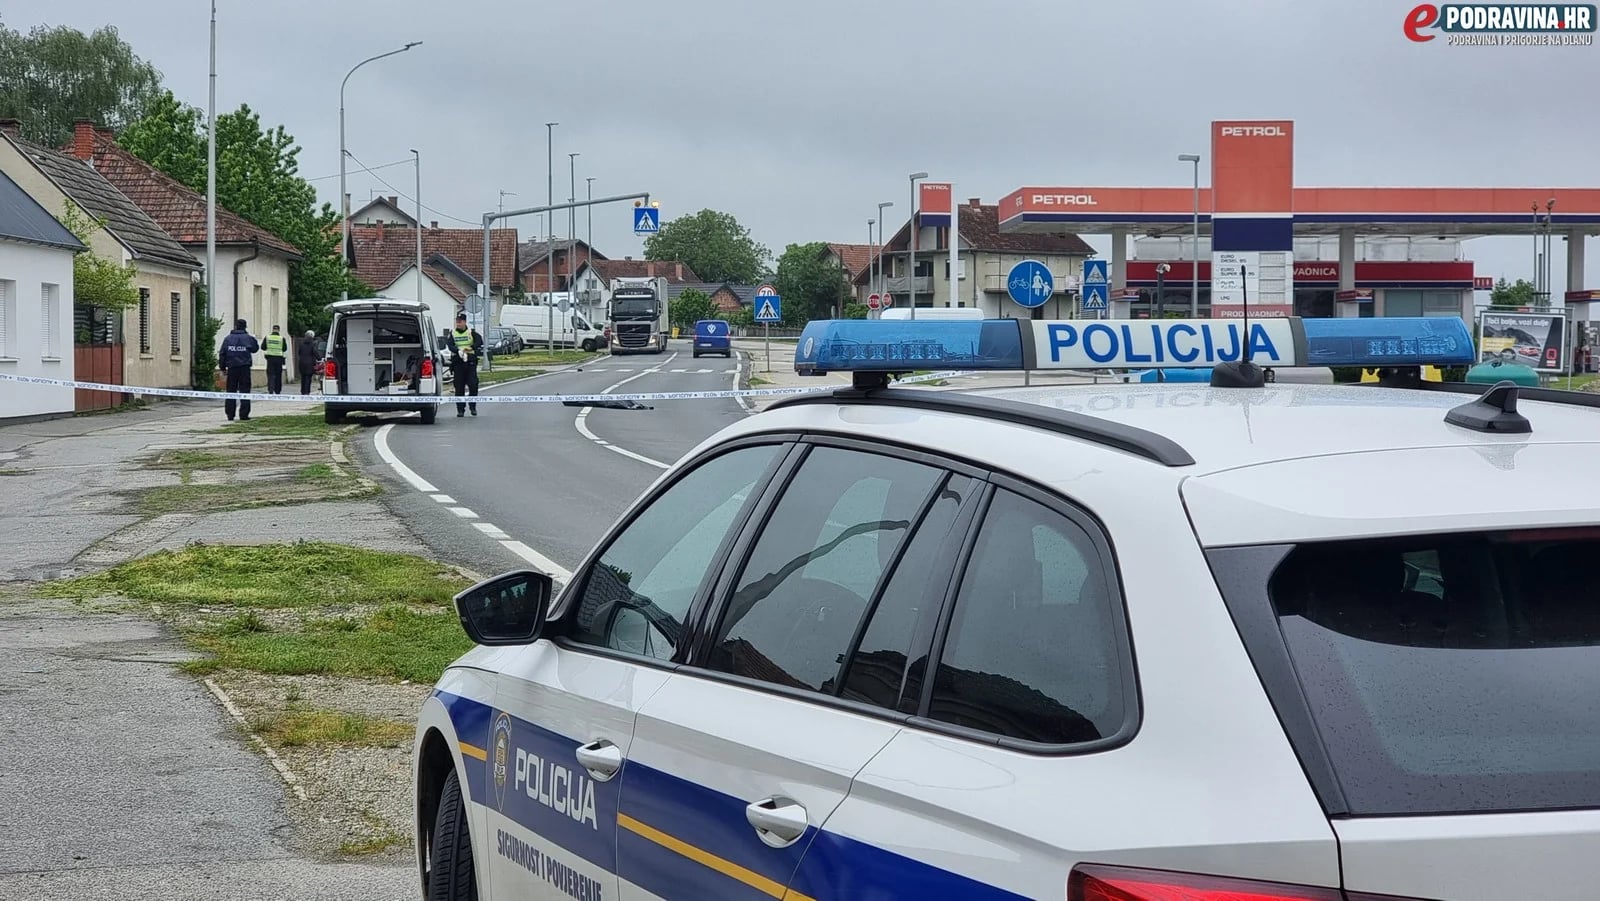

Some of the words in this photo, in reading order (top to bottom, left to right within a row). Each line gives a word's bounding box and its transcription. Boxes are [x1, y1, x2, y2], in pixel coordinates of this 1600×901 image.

[1221, 126, 1286, 137] PETROL
[1032, 195, 1098, 205] PETROL
[1047, 324, 1280, 362] POLICIJA
[515, 747, 598, 831] POLICIJA
[497, 828, 540, 876] SIGURNOST
[540, 853, 545, 880] I
